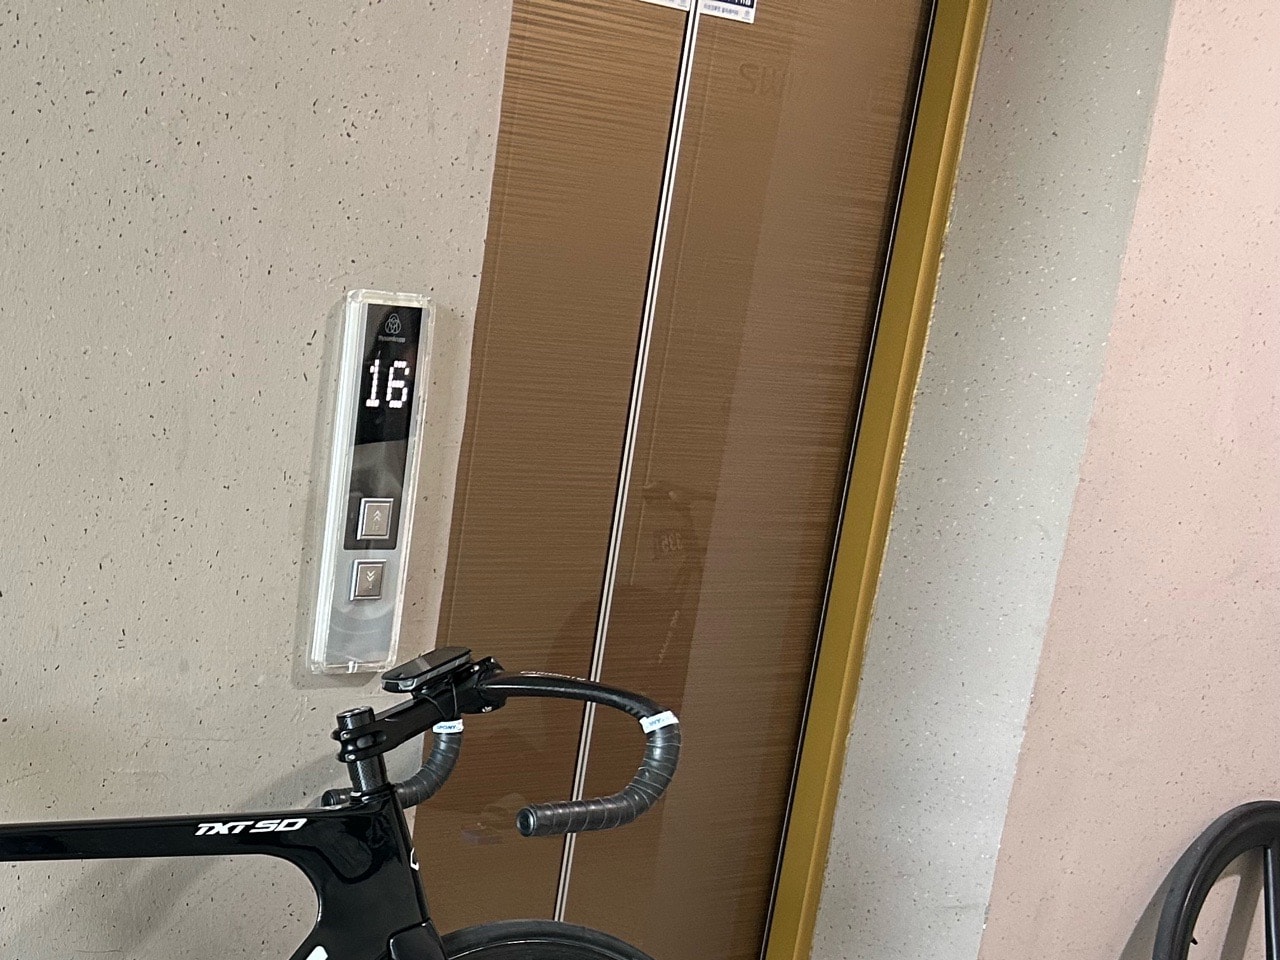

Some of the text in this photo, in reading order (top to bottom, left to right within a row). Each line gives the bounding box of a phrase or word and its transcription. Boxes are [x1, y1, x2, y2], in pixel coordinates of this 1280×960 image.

[365, 358, 410, 409] 16
[194, 817, 308, 836] TXT SD
